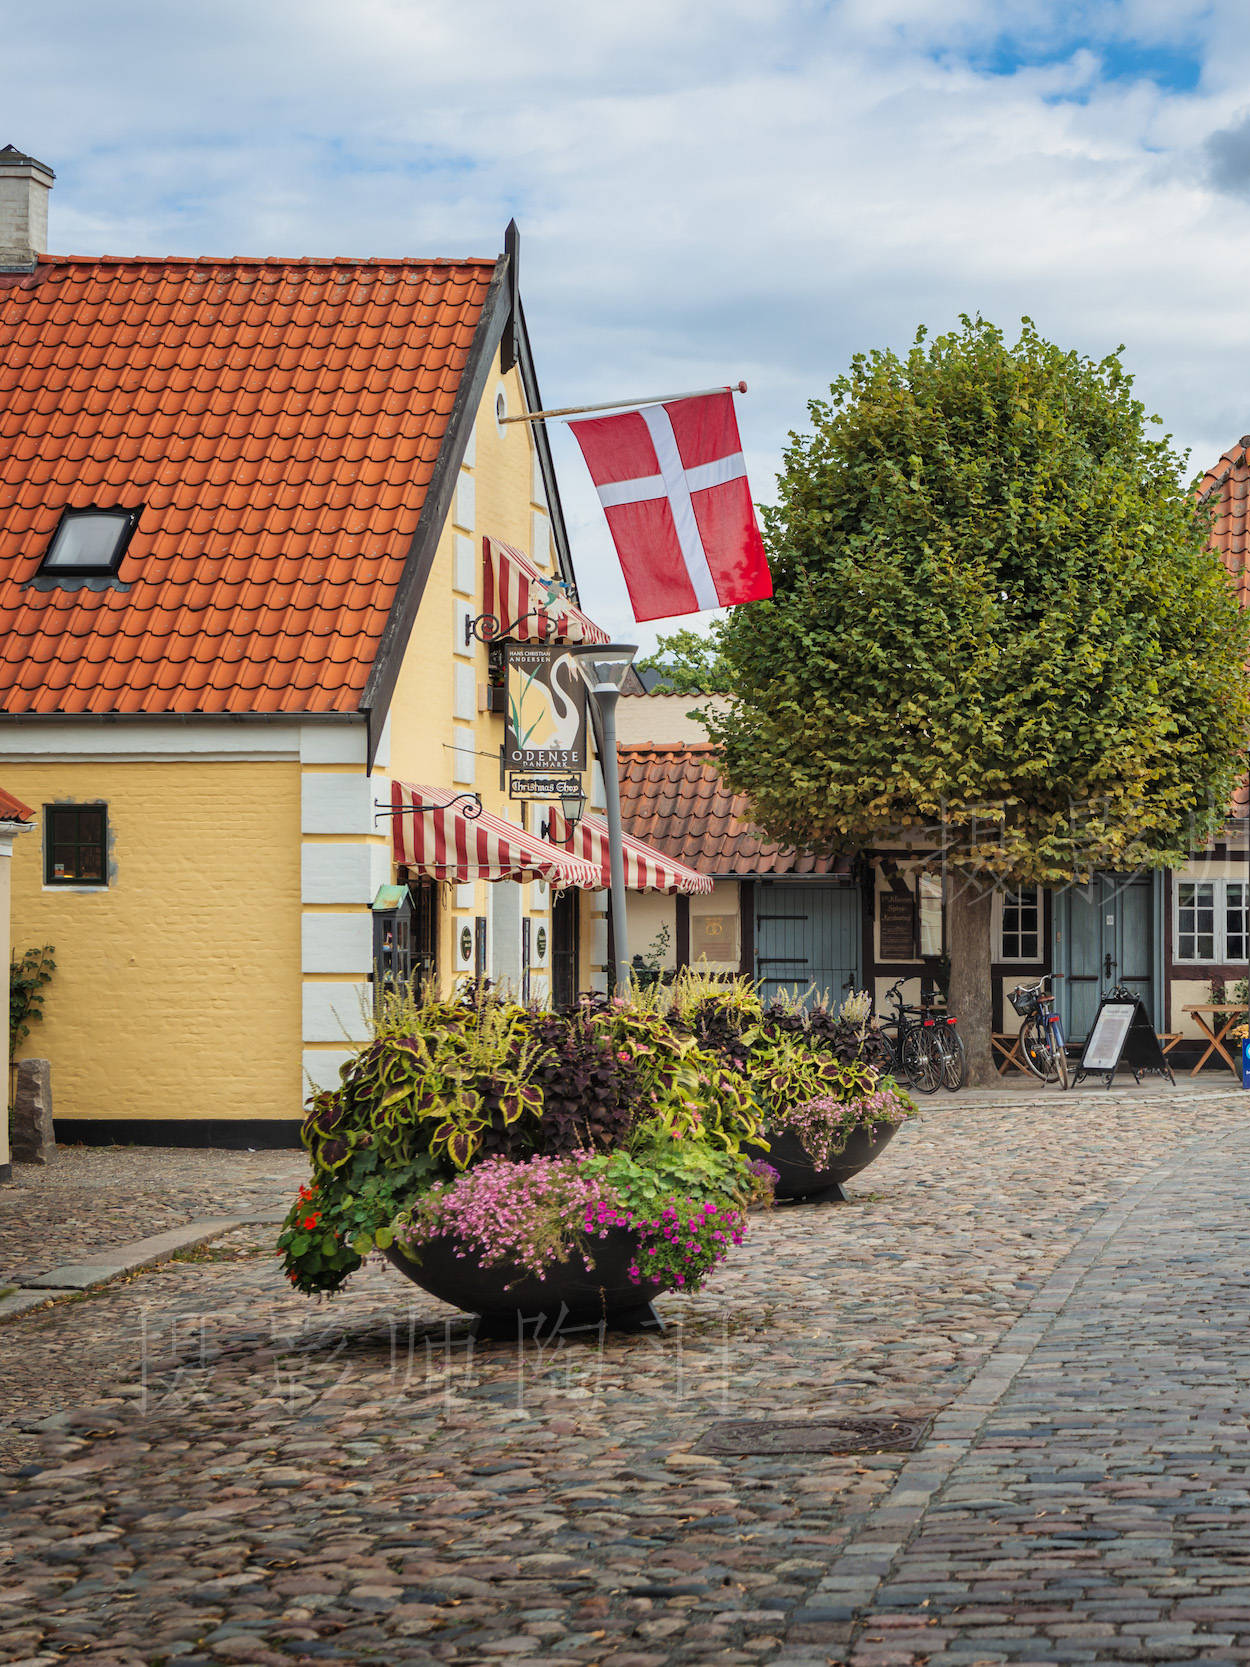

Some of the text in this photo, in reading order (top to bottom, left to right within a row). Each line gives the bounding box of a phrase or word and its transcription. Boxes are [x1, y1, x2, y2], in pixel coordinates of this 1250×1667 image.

[512, 750, 579, 762] ODENSE
[511, 780, 579, 793] Christmas Shop
